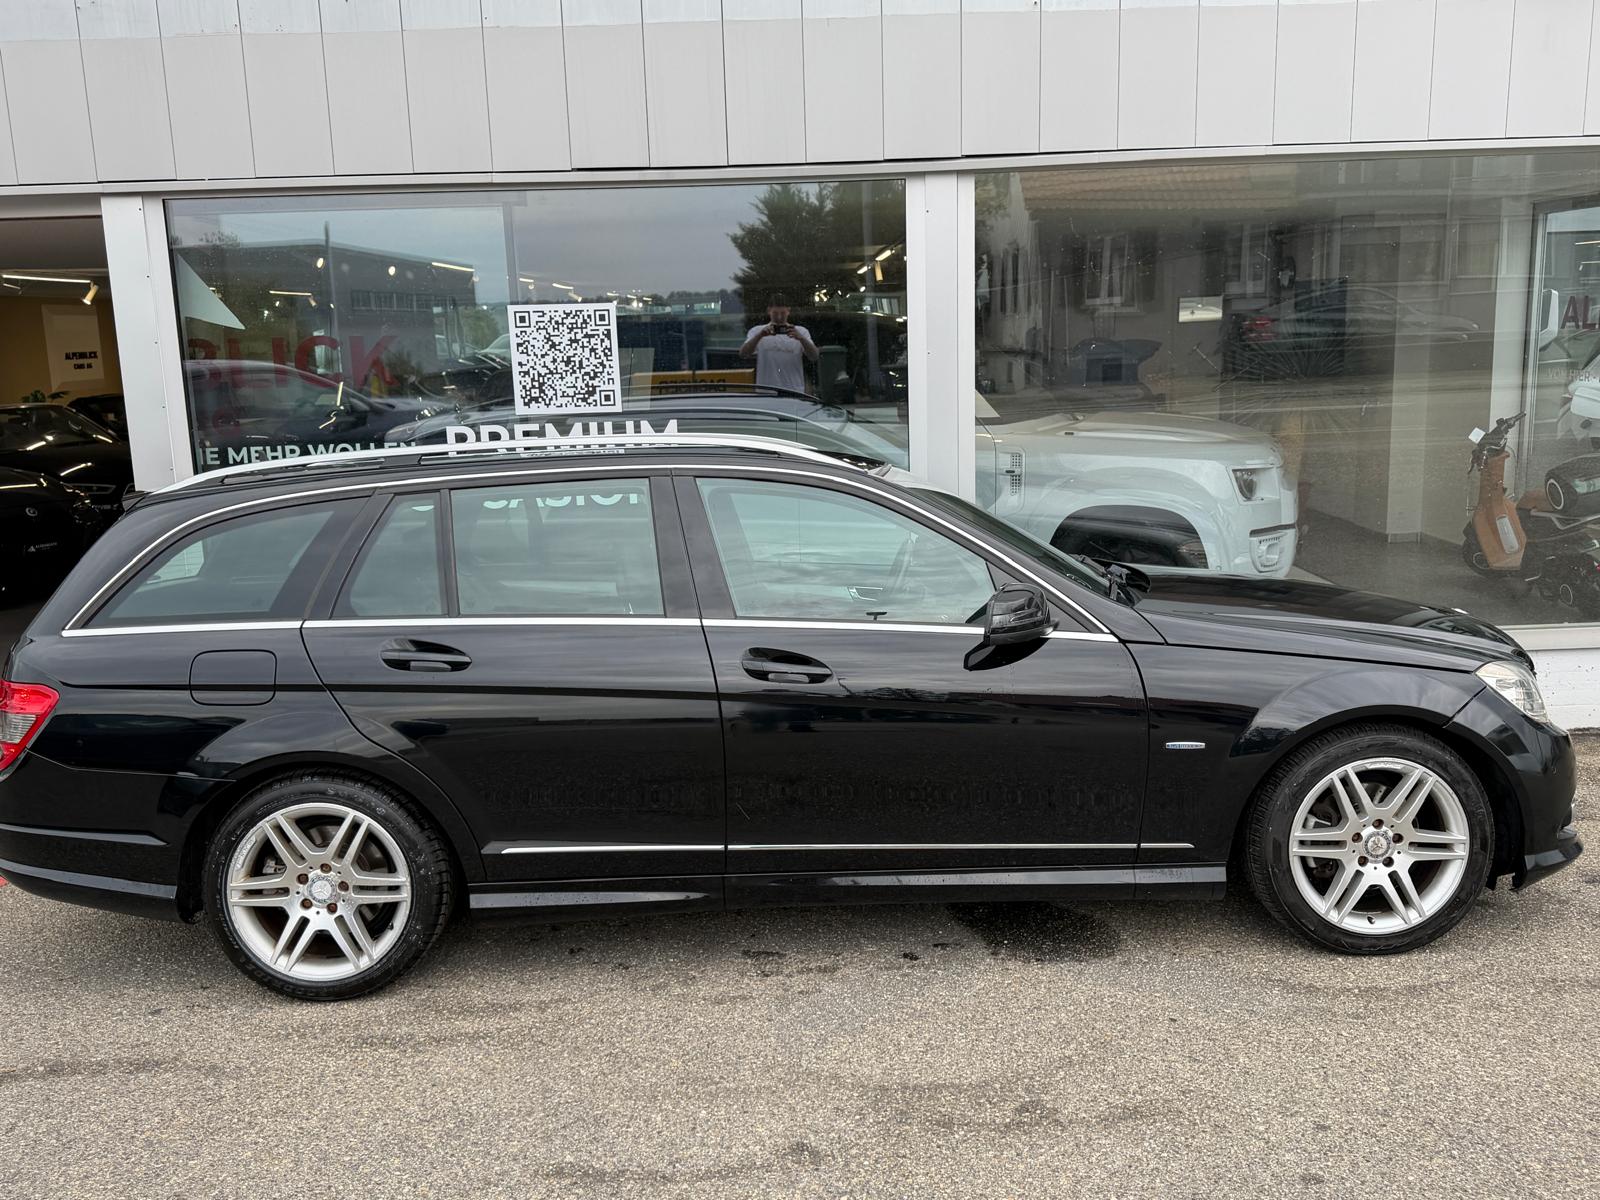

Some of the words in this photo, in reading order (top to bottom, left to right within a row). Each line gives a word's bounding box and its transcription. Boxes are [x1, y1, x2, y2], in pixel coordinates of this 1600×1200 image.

[1560, 295, 1600, 329] AL
[227, 445, 300, 464] MEHR
[446, 419, 678, 456] PREMIUM
